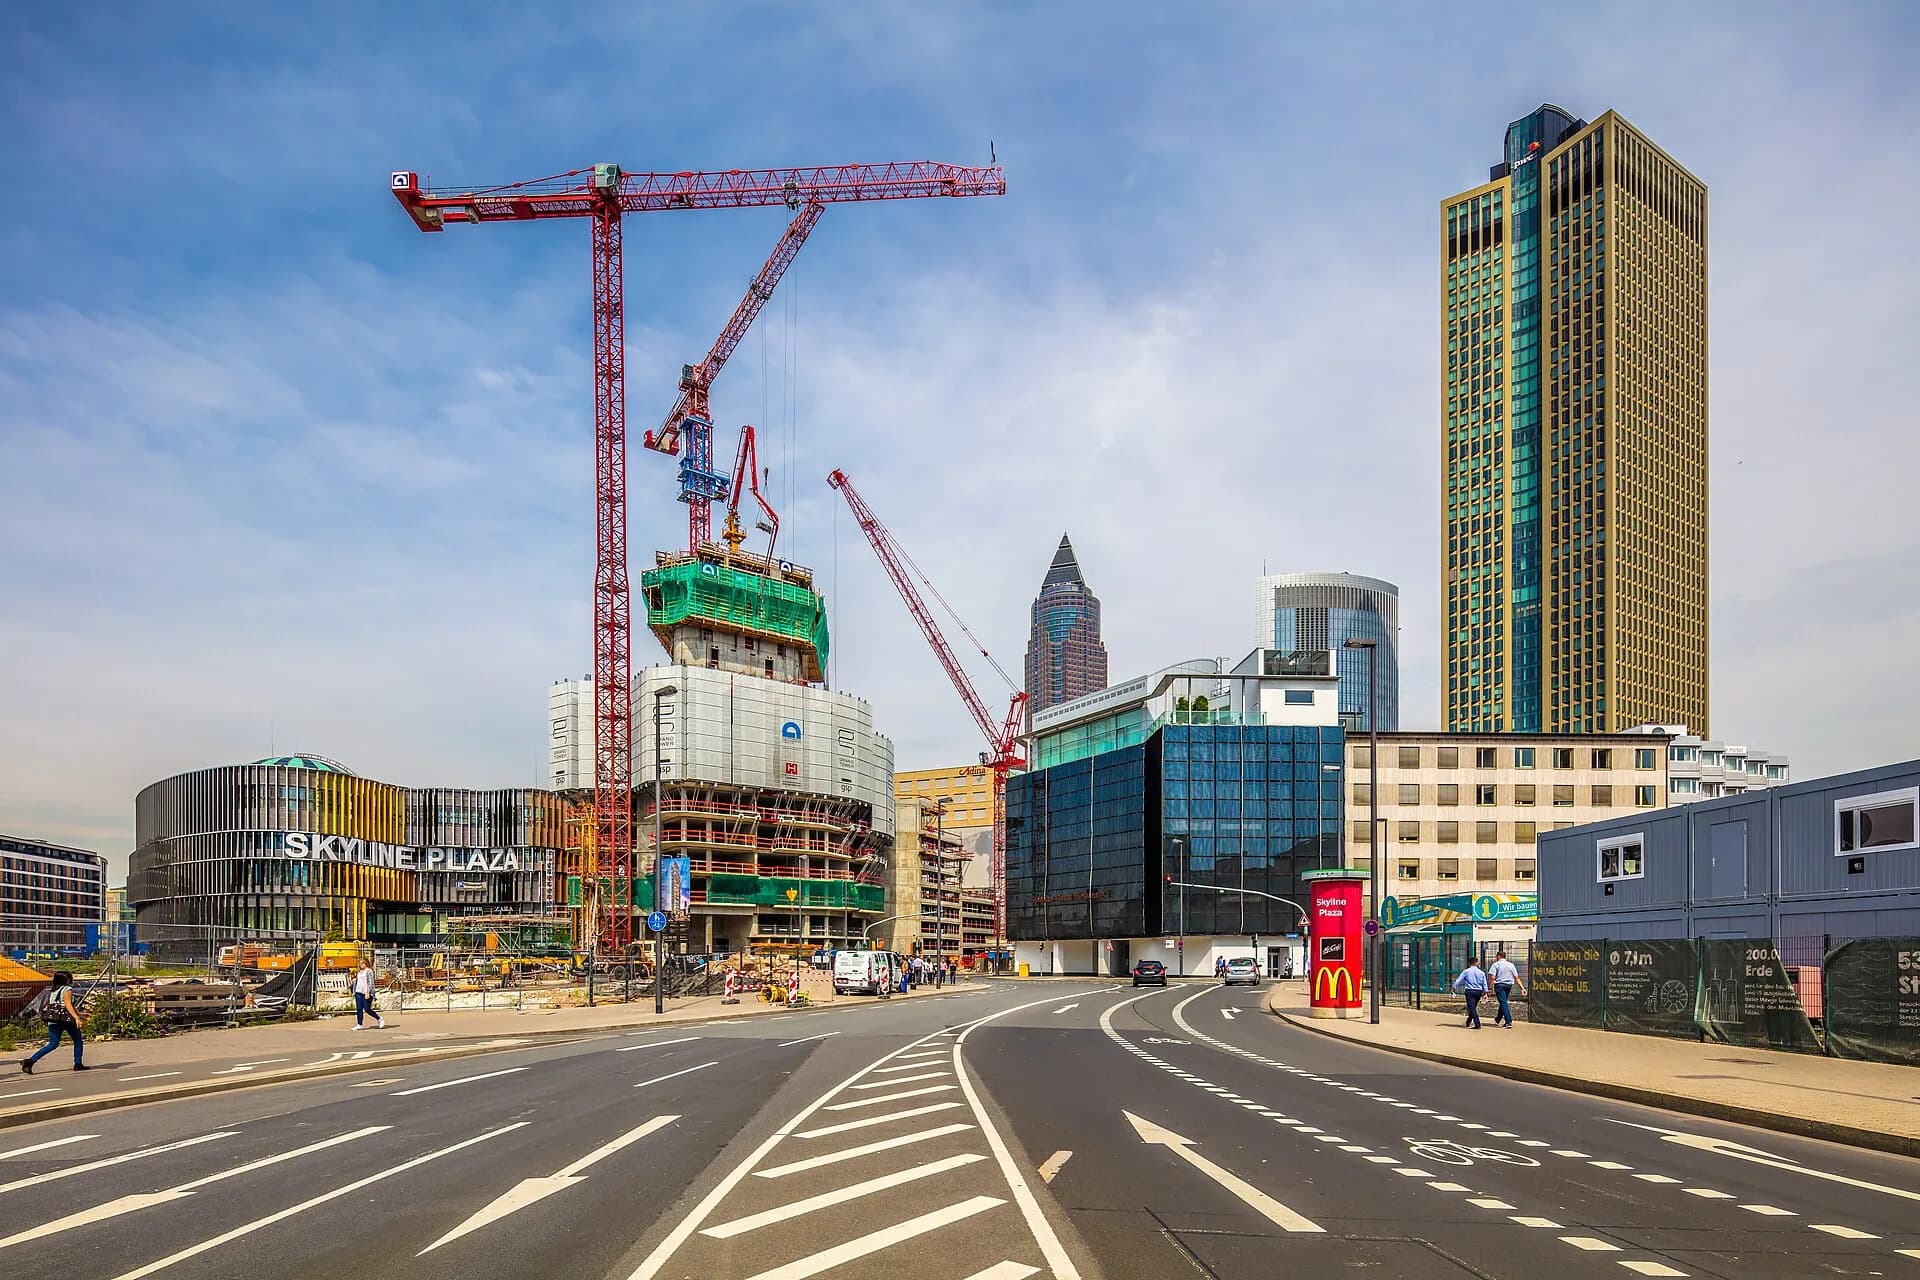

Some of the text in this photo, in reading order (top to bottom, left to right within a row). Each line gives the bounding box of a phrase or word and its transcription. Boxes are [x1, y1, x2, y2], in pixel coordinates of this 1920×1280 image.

[959, 765, 986, 775] Adina
[285, 833, 519, 870] SKYLINE PLAZA
[1317, 898, 1347, 908] Skyline
[1502, 902, 1537, 911] Wir bauen
[1319, 909, 1343, 917] Plaza
[1533, 949, 1600, 961] Wir bauen die
[1533, 964, 1587, 977] neue Stadt-
[1745, 964, 1773, 977] Erde
[1533, 979, 1591, 993] bahnlinie U5.
